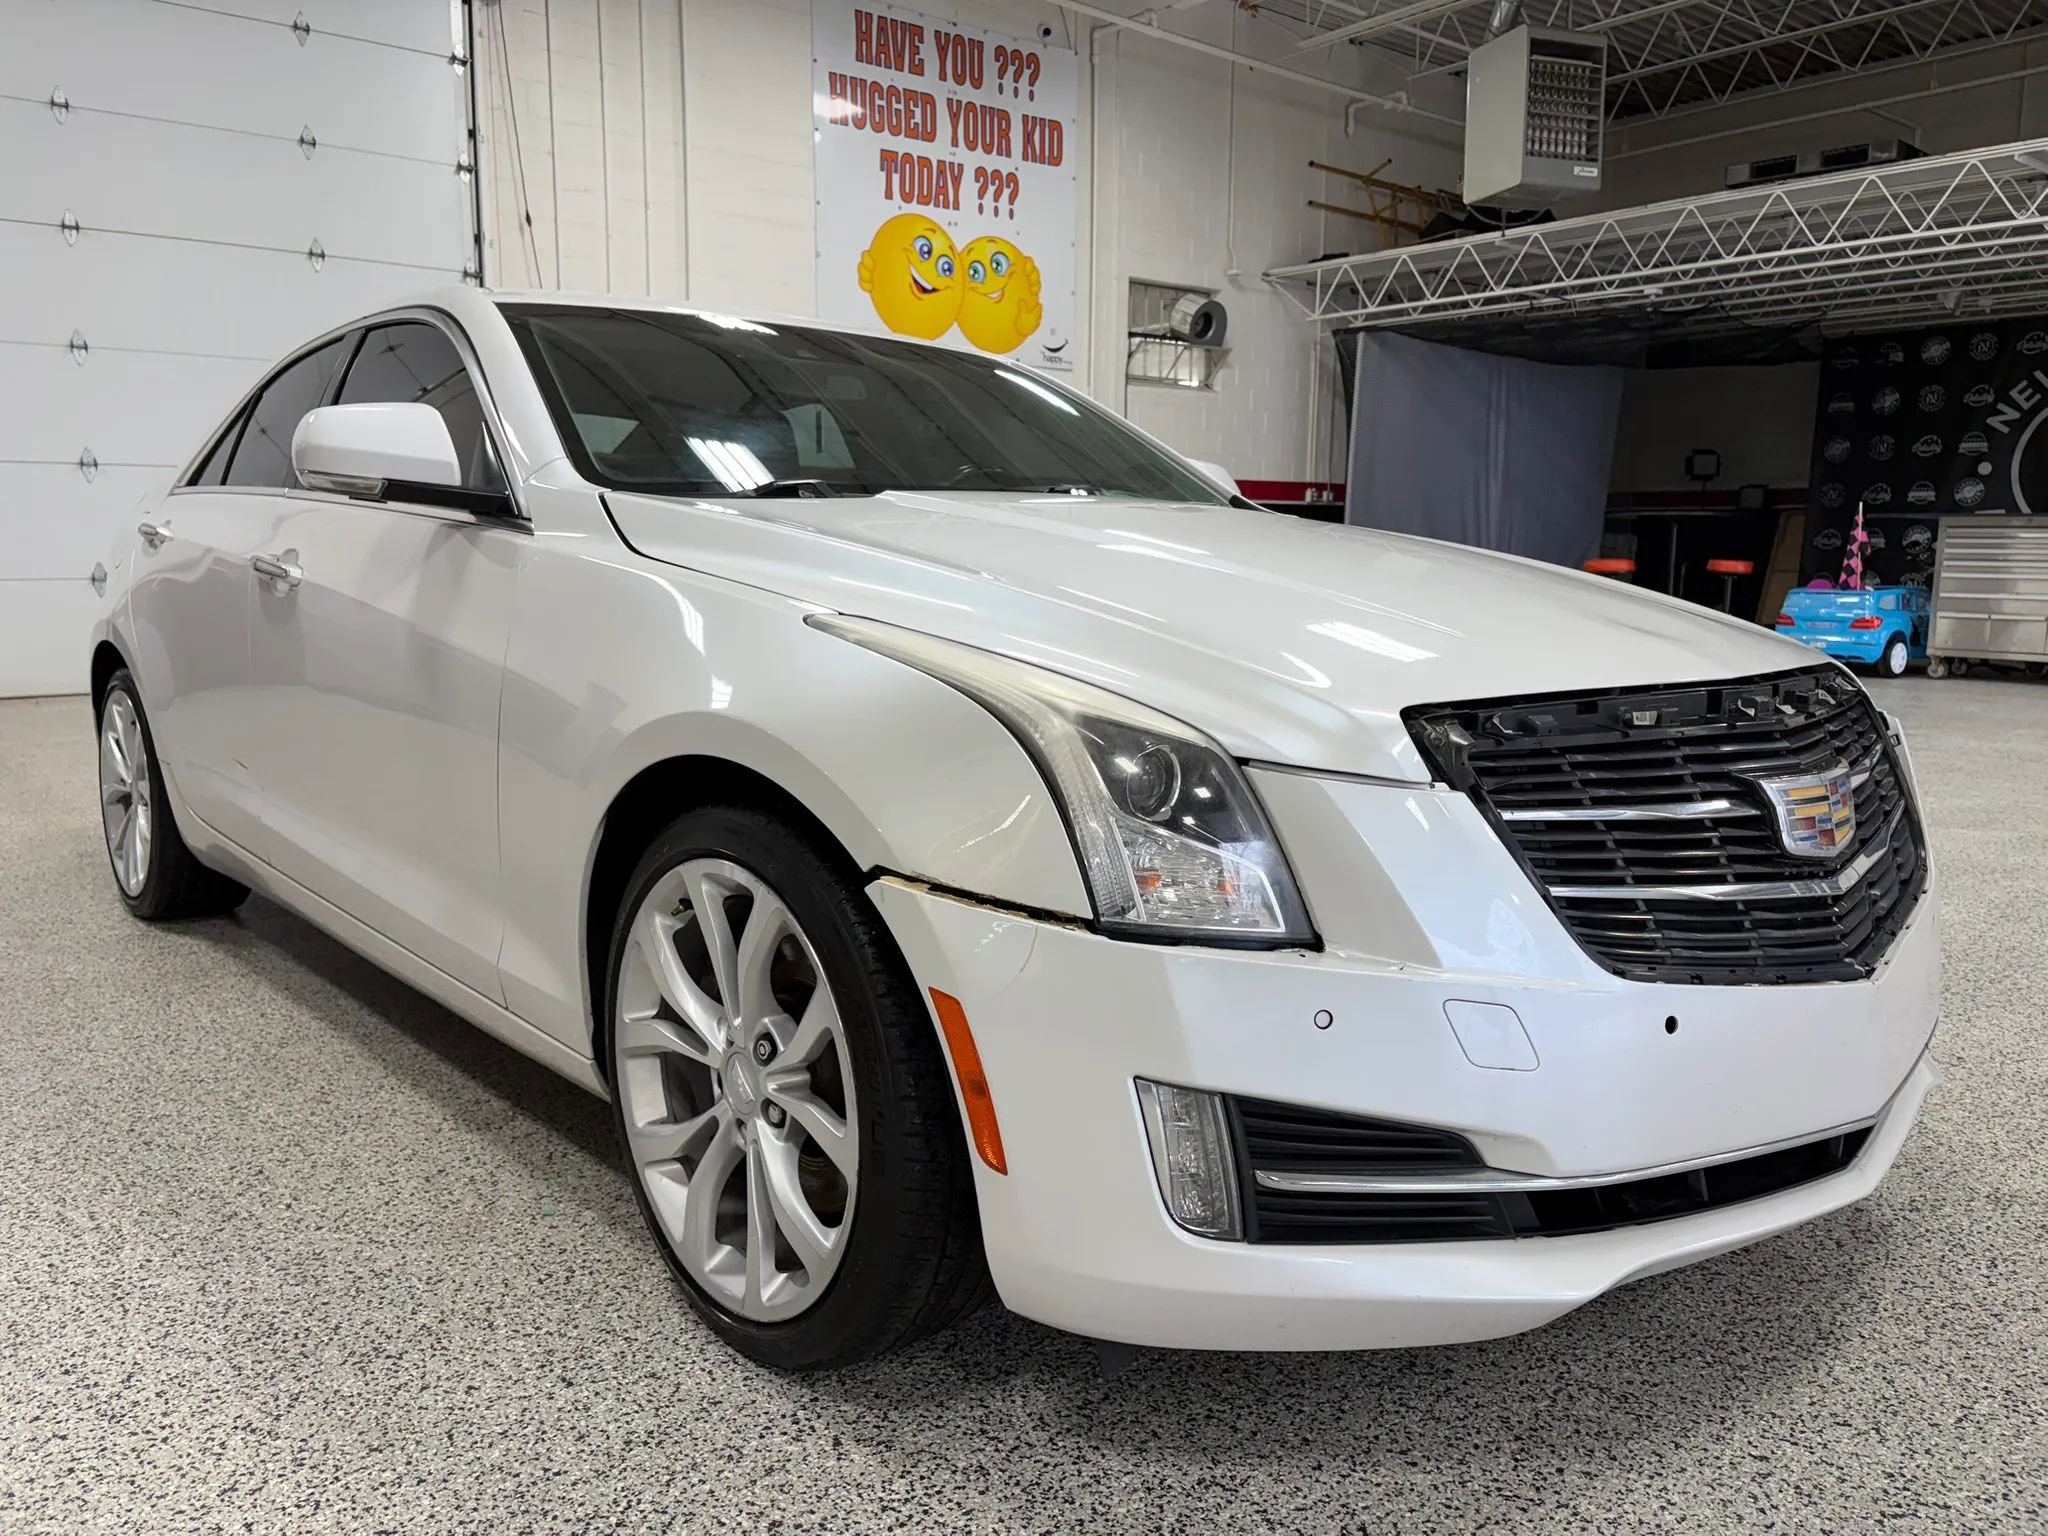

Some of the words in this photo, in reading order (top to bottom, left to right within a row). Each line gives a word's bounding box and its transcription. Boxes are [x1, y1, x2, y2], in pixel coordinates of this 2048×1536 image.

[855, 9, 924, 77] HAVE
[934, 30, 984, 90] YOU
[993, 45, 1041, 103] ???
[829, 72, 938, 143] HUGGED
[946, 98, 1012, 158] YOUR
[1021, 115, 1065, 168] KID
[880, 148, 964, 211] TODAY
[974, 166, 1020, 221] ???
